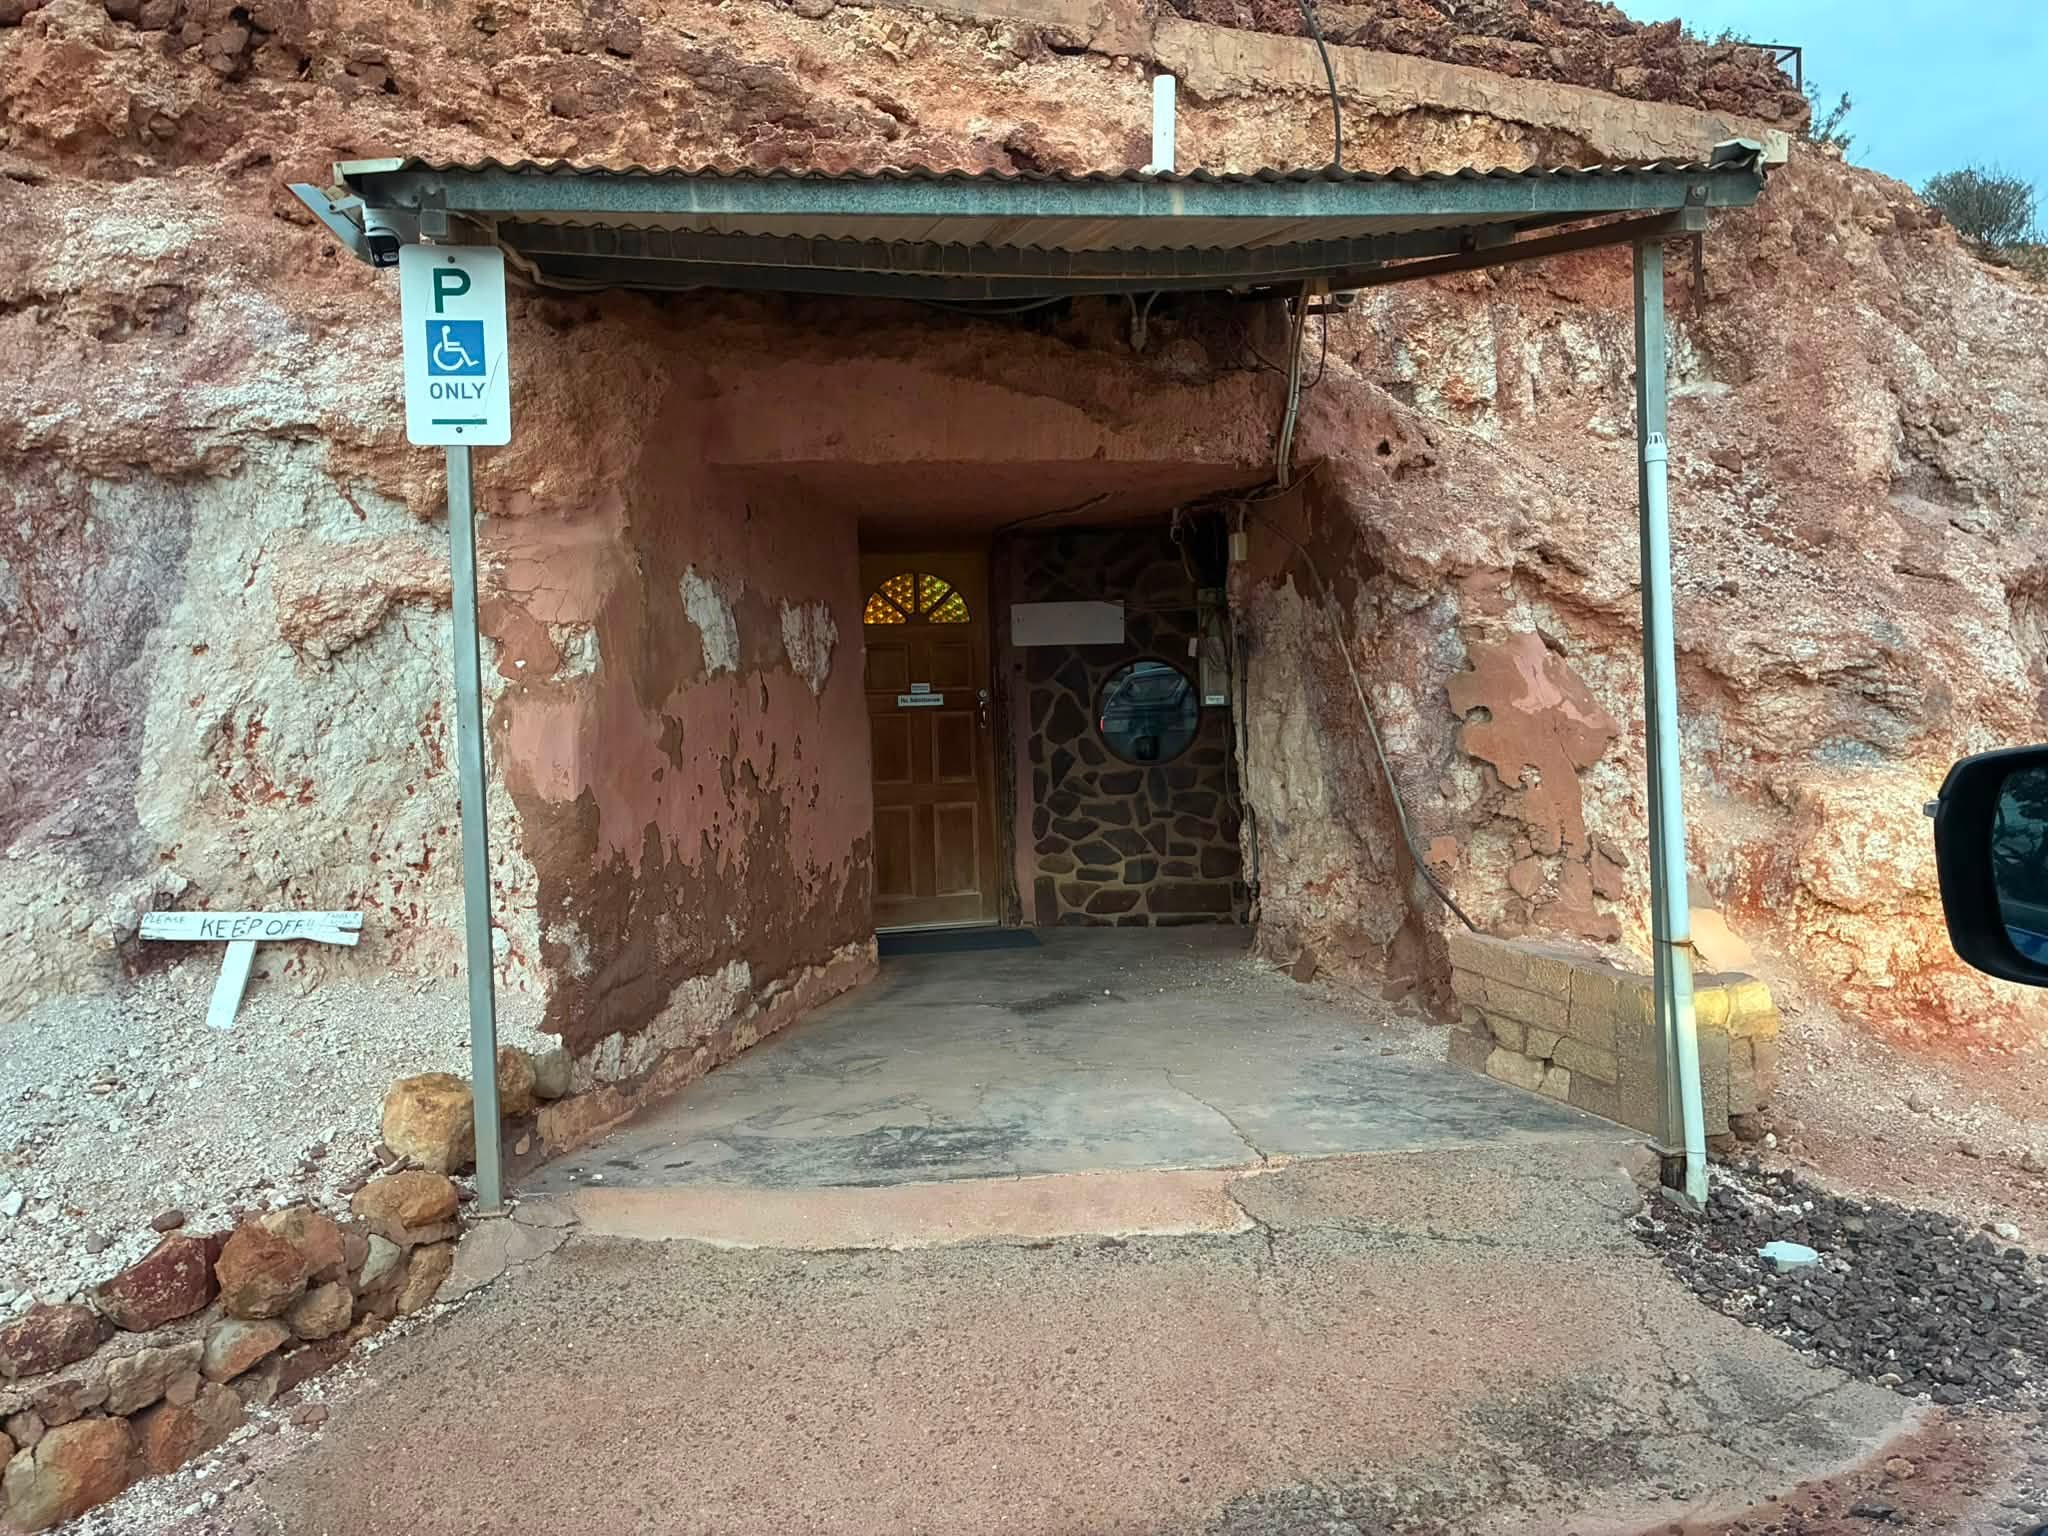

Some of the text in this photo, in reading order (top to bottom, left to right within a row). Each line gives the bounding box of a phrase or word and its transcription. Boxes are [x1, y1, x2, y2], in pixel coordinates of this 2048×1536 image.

[433, 268, 471, 313] P
[430, 382, 486, 399] ONLY
[200, 917, 262, 938] KEEP
